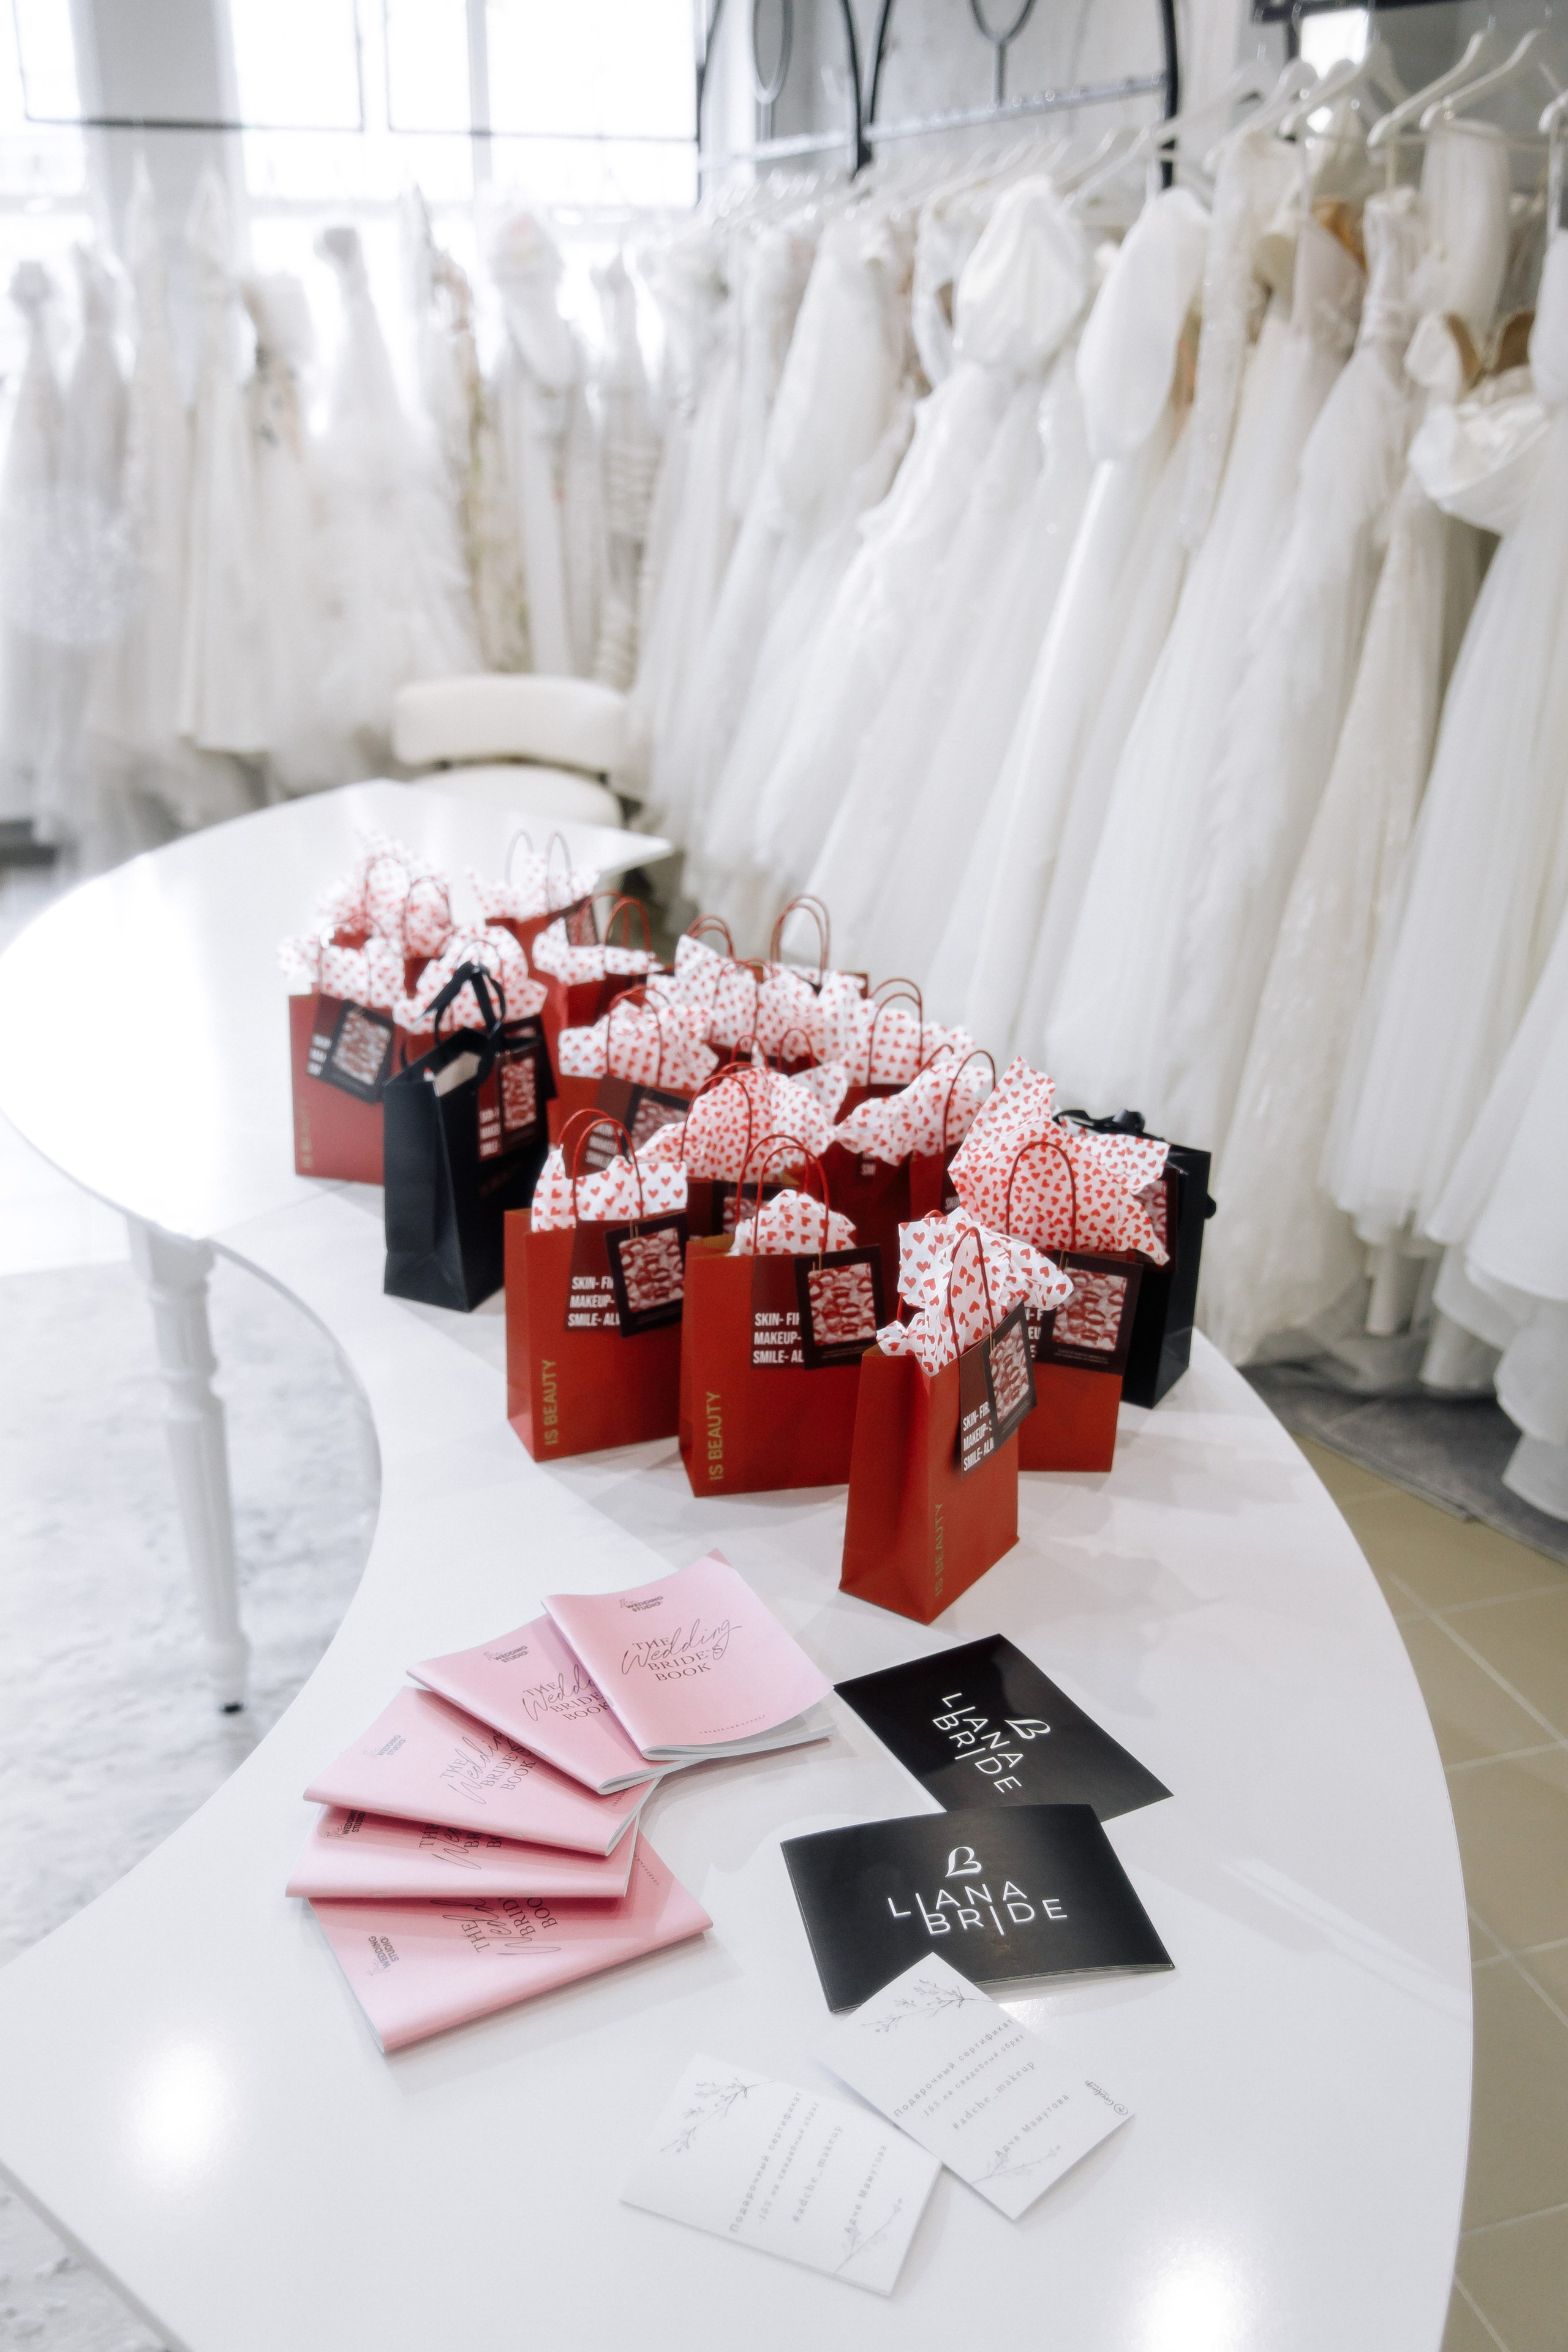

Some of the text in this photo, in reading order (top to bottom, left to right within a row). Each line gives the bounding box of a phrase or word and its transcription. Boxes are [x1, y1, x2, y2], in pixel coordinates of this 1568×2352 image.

[754, 1312, 785, 1327] SKIN-
[753, 1331, 802, 1346] MAKEUP-
[752, 1349, 790, 1364] SMILE-
[541, 1359, 559, 1446] IS BEAUTY
[706, 1390, 724, 1481] IS BEAUTY
[963, 1409, 979, 1432] SKIN-
[963, 1423, 989, 1452] MAKEUP-
[963, 1446, 983, 1471] SMILE-
[935, 1503, 944, 1576] BEAUTY
[621, 1618, 742, 1675] Wedding
[632, 1637, 671, 1651] THE
[655, 1662, 712, 1681] BOOK
[522, 1682, 559, 1698] THE
[439, 1758, 469, 1778] THE
[932, 1714, 1022, 1793] BRIDE
[500, 1760, 537, 1791] BOOK
[925, 1898, 1068, 1936] BRIDE
[368, 1936, 391, 1969] WEDDING
[461, 1920, 491, 1953] THE
[893, 2018, 1014, 2118] Подарочный сертификат
[943, 2088, 954, 2100] на
[956, 2050, 1000, 2090] свадебный
[1001, 2034, 1025, 2052] образ
[952, 2060, 1036, 2131] #adche_makeup
[778, 2128, 805, 2180] свадебный
[804, 2101, 820, 2127] образ
[994, 2094, 1070, 2158] Адче Мамутова
[729, 2091, 803, 2233] Подарочный сертификат
[843, 2144, 888, 2234] Адче Мамутова
